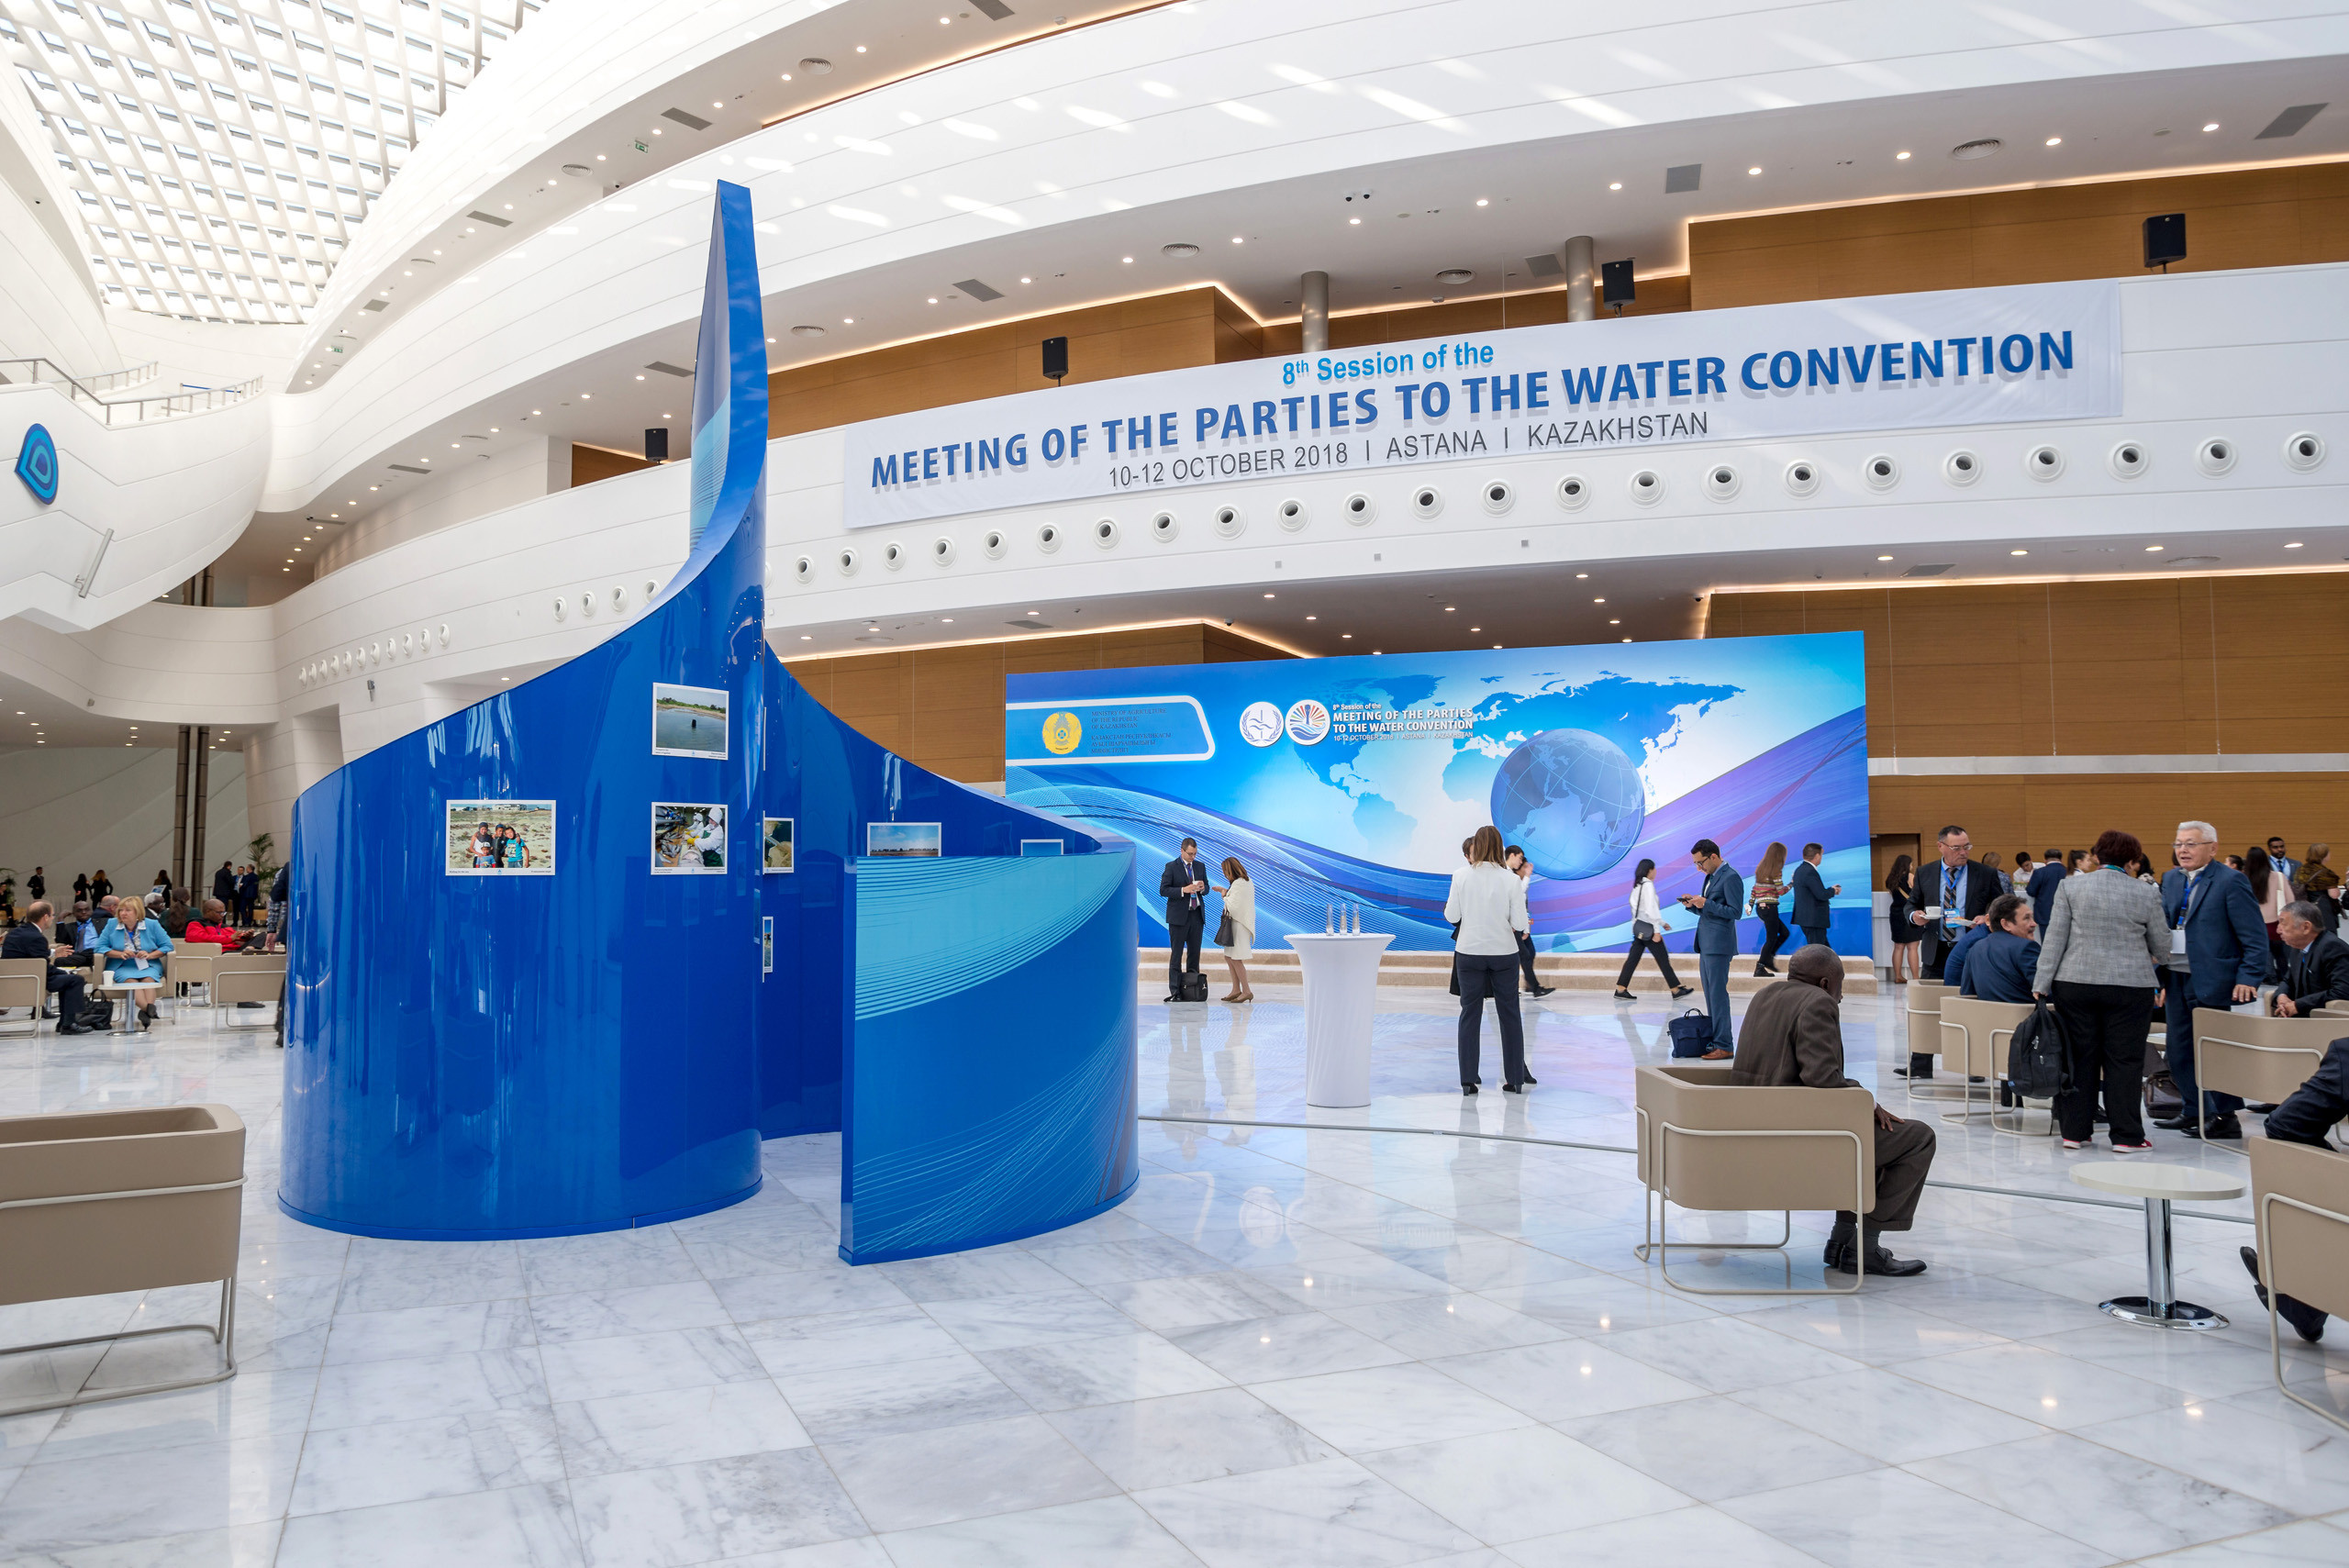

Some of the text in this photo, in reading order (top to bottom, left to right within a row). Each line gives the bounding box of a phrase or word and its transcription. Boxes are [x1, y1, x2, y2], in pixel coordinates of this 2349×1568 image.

[1282, 341, 1494, 385] 8th Session of the
[872, 330, 2073, 488] MEETING OF THE PARTIES TO THE WATER CONVENTION
[1108, 462, 1163, 488] 10-12
[1173, 449, 1286, 480] OCTOBER
[1294, 442, 1348, 468] 2018
[1386, 429, 1487, 460] ASTANA
[1528, 411, 1708, 448] KAZAKHSTAN
[1332, 720, 1474, 734] TO THE WATER CONVENTION
[1333, 707, 1474, 722] MEETING OF THE PARTIES
